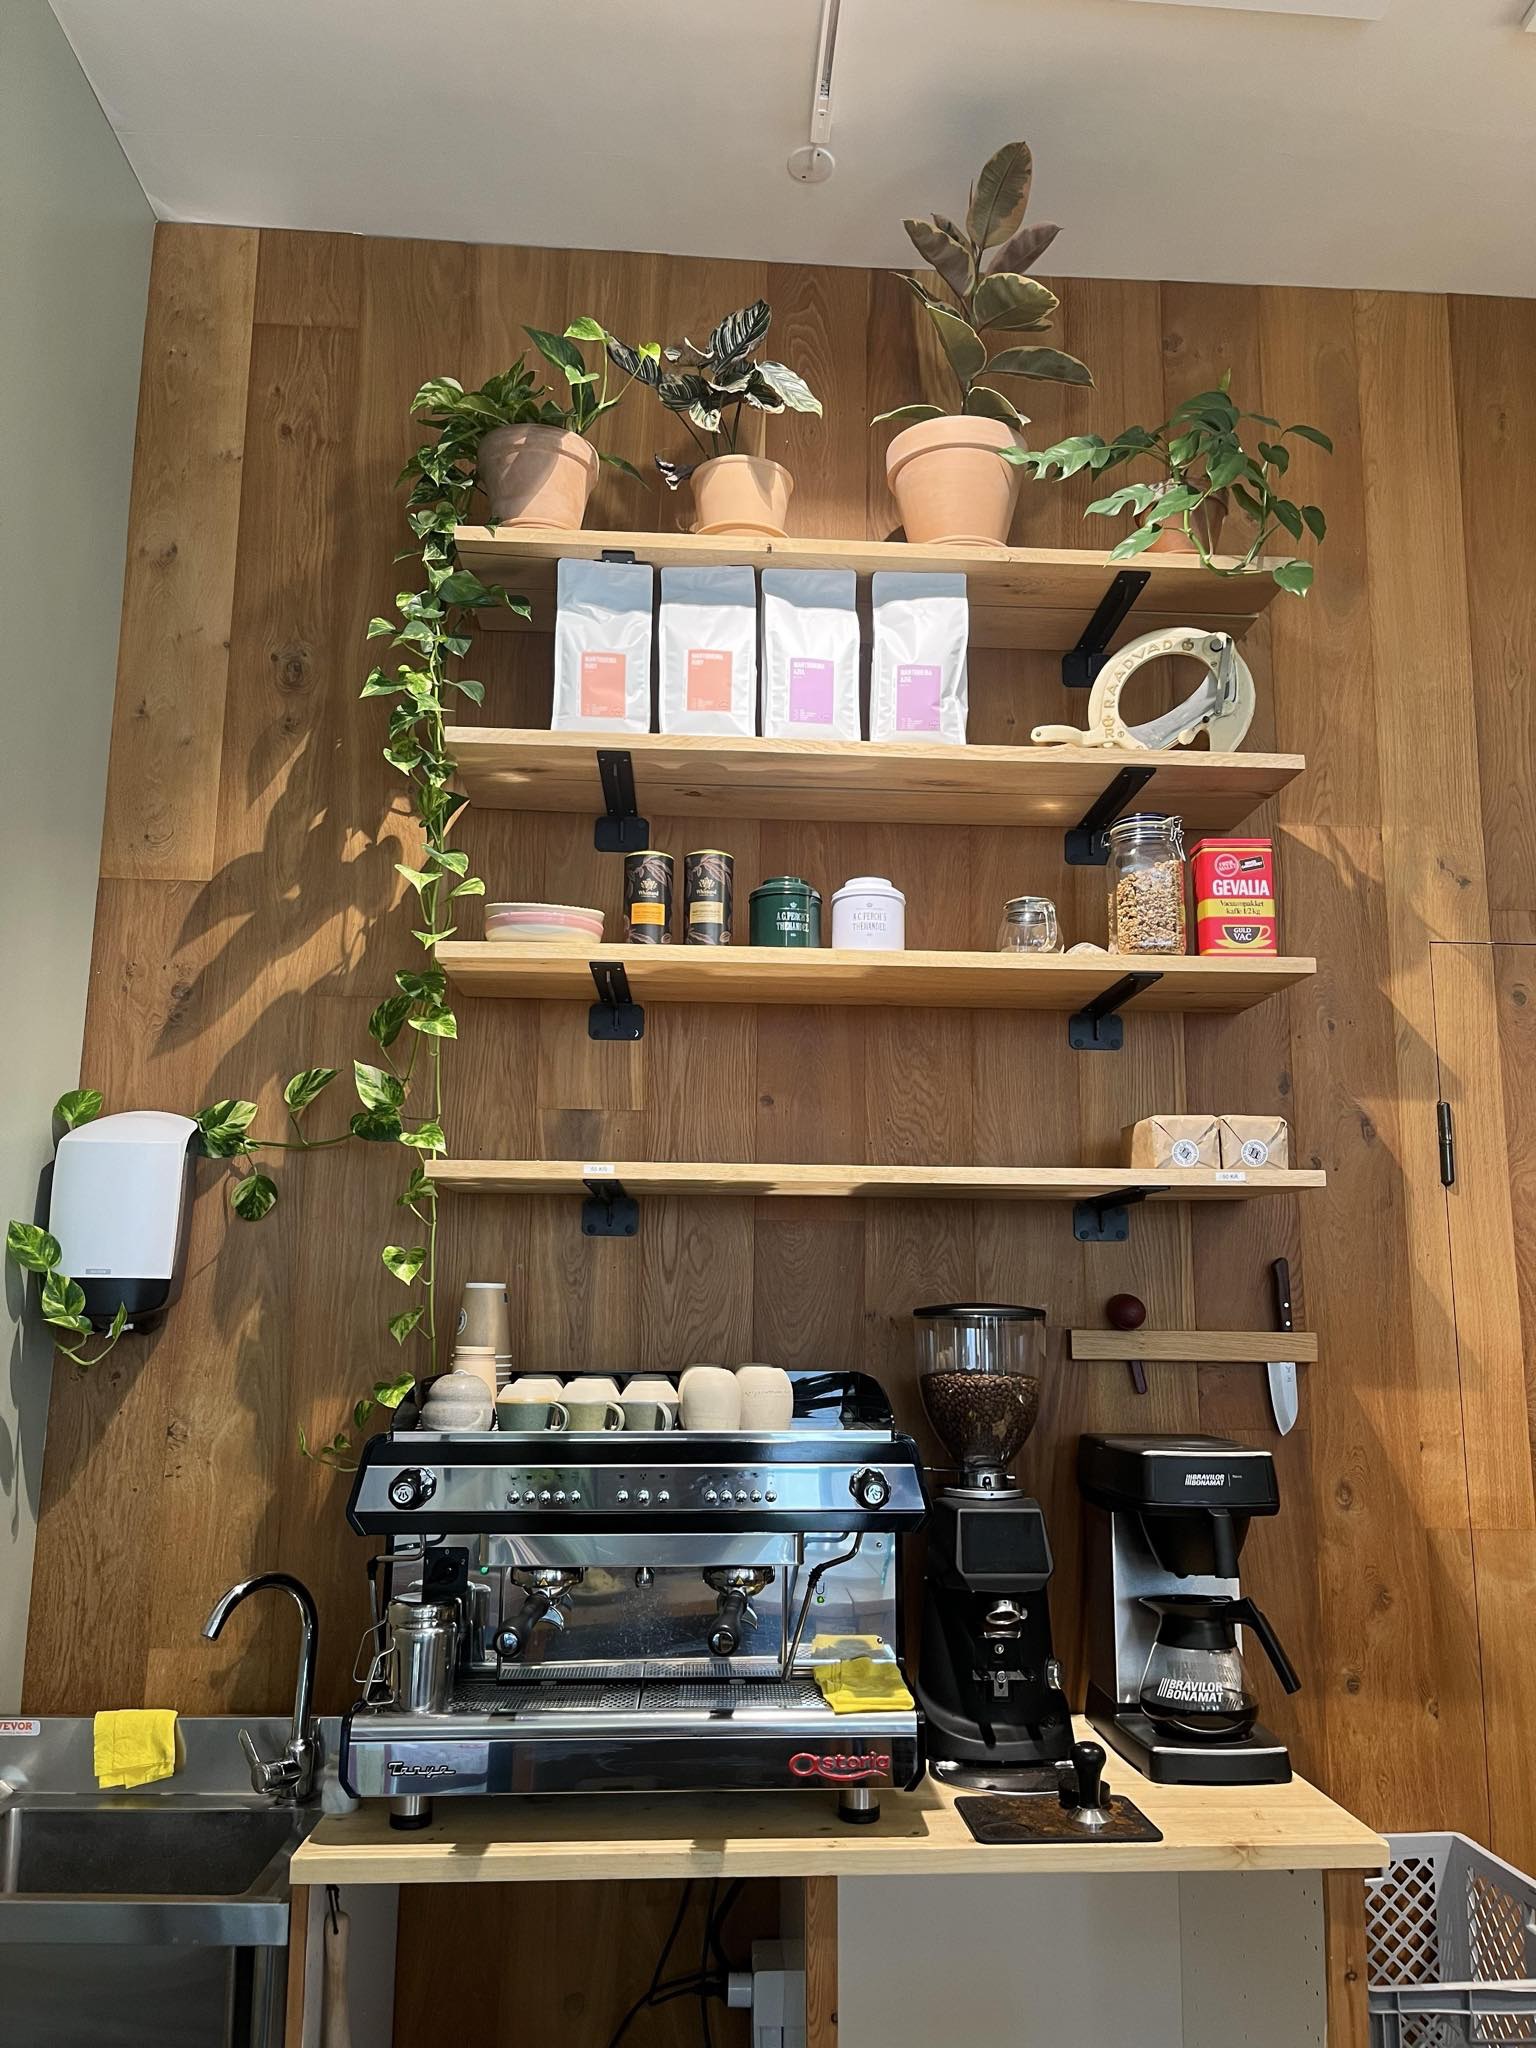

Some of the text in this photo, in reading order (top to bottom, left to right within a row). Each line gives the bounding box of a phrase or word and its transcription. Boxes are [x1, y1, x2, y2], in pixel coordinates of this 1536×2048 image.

[1104, 640, 1172, 709] RAADVAD
[1212, 879, 1270, 895] GEVALIA
[1233, 933, 1252, 941] VAC
[1169, 1680, 1223, 1692] BRAVILOR
[1166, 1689, 1223, 1702] BONAMAT
